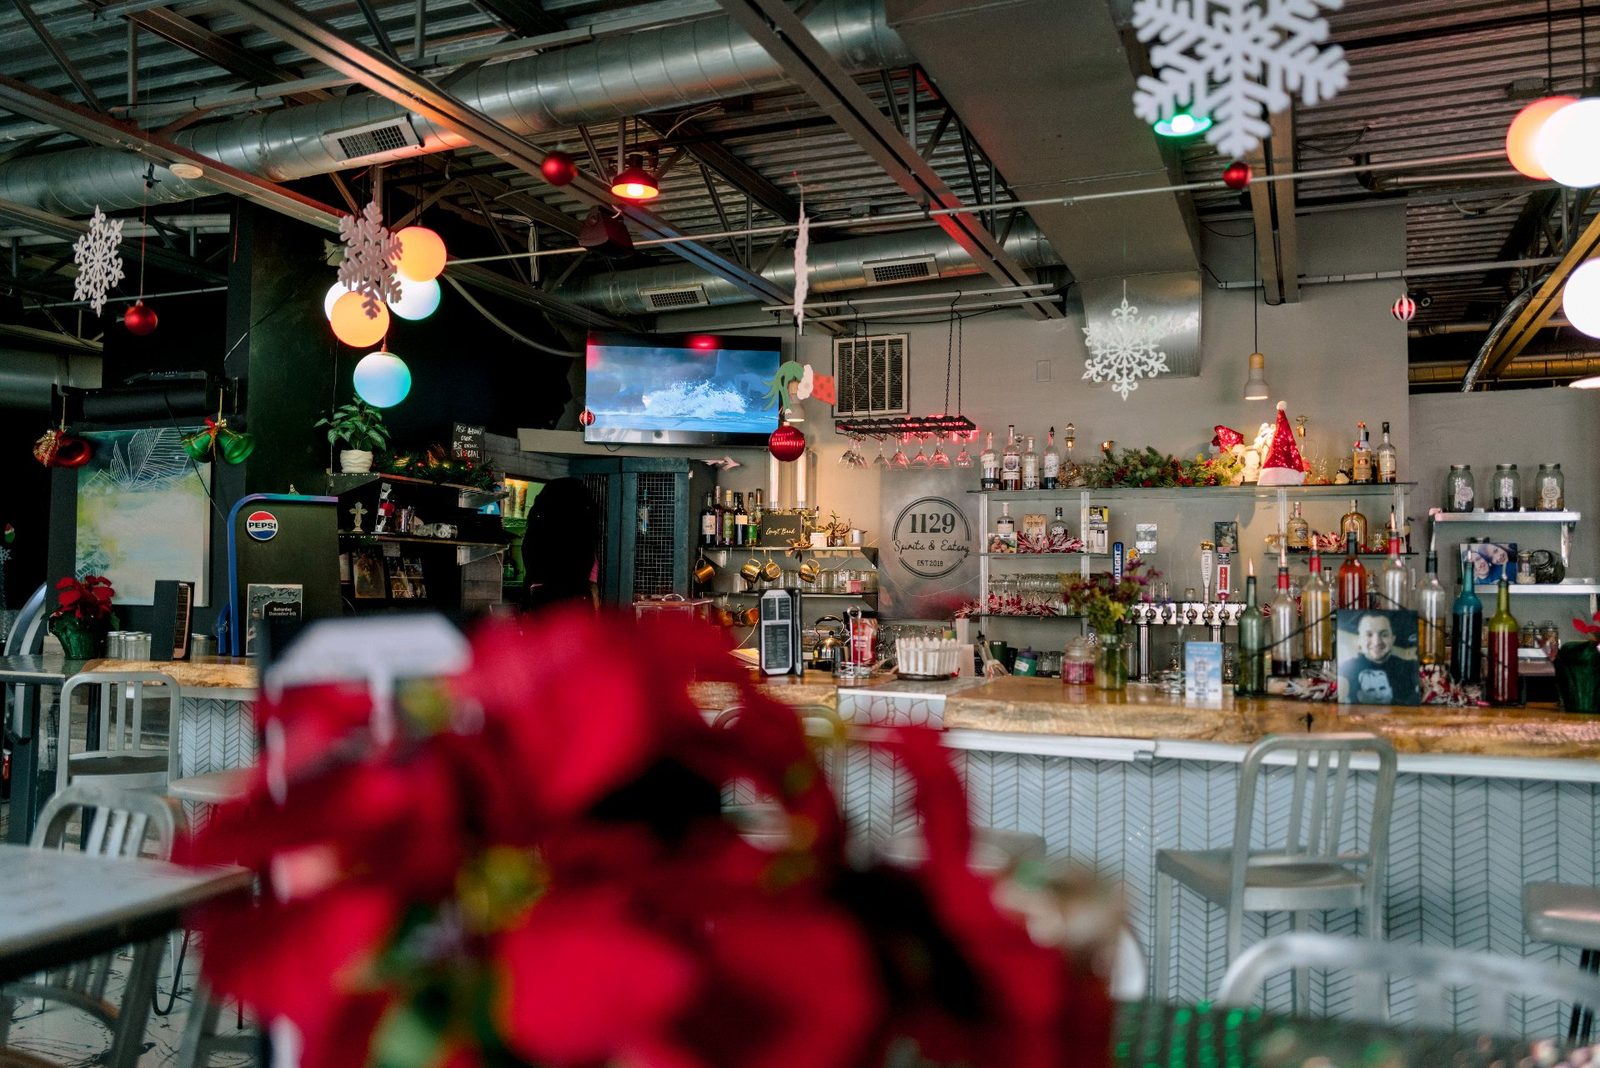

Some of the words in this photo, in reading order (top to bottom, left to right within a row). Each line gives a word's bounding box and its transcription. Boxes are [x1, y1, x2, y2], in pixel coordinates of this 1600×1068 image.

[456, 449, 480, 458] SPCIAL
[909, 513, 956, 534] 1129
[893, 539, 926, 556] Spirits
[928, 540, 936, 551] &
[940, 539, 970, 558] Eatery
